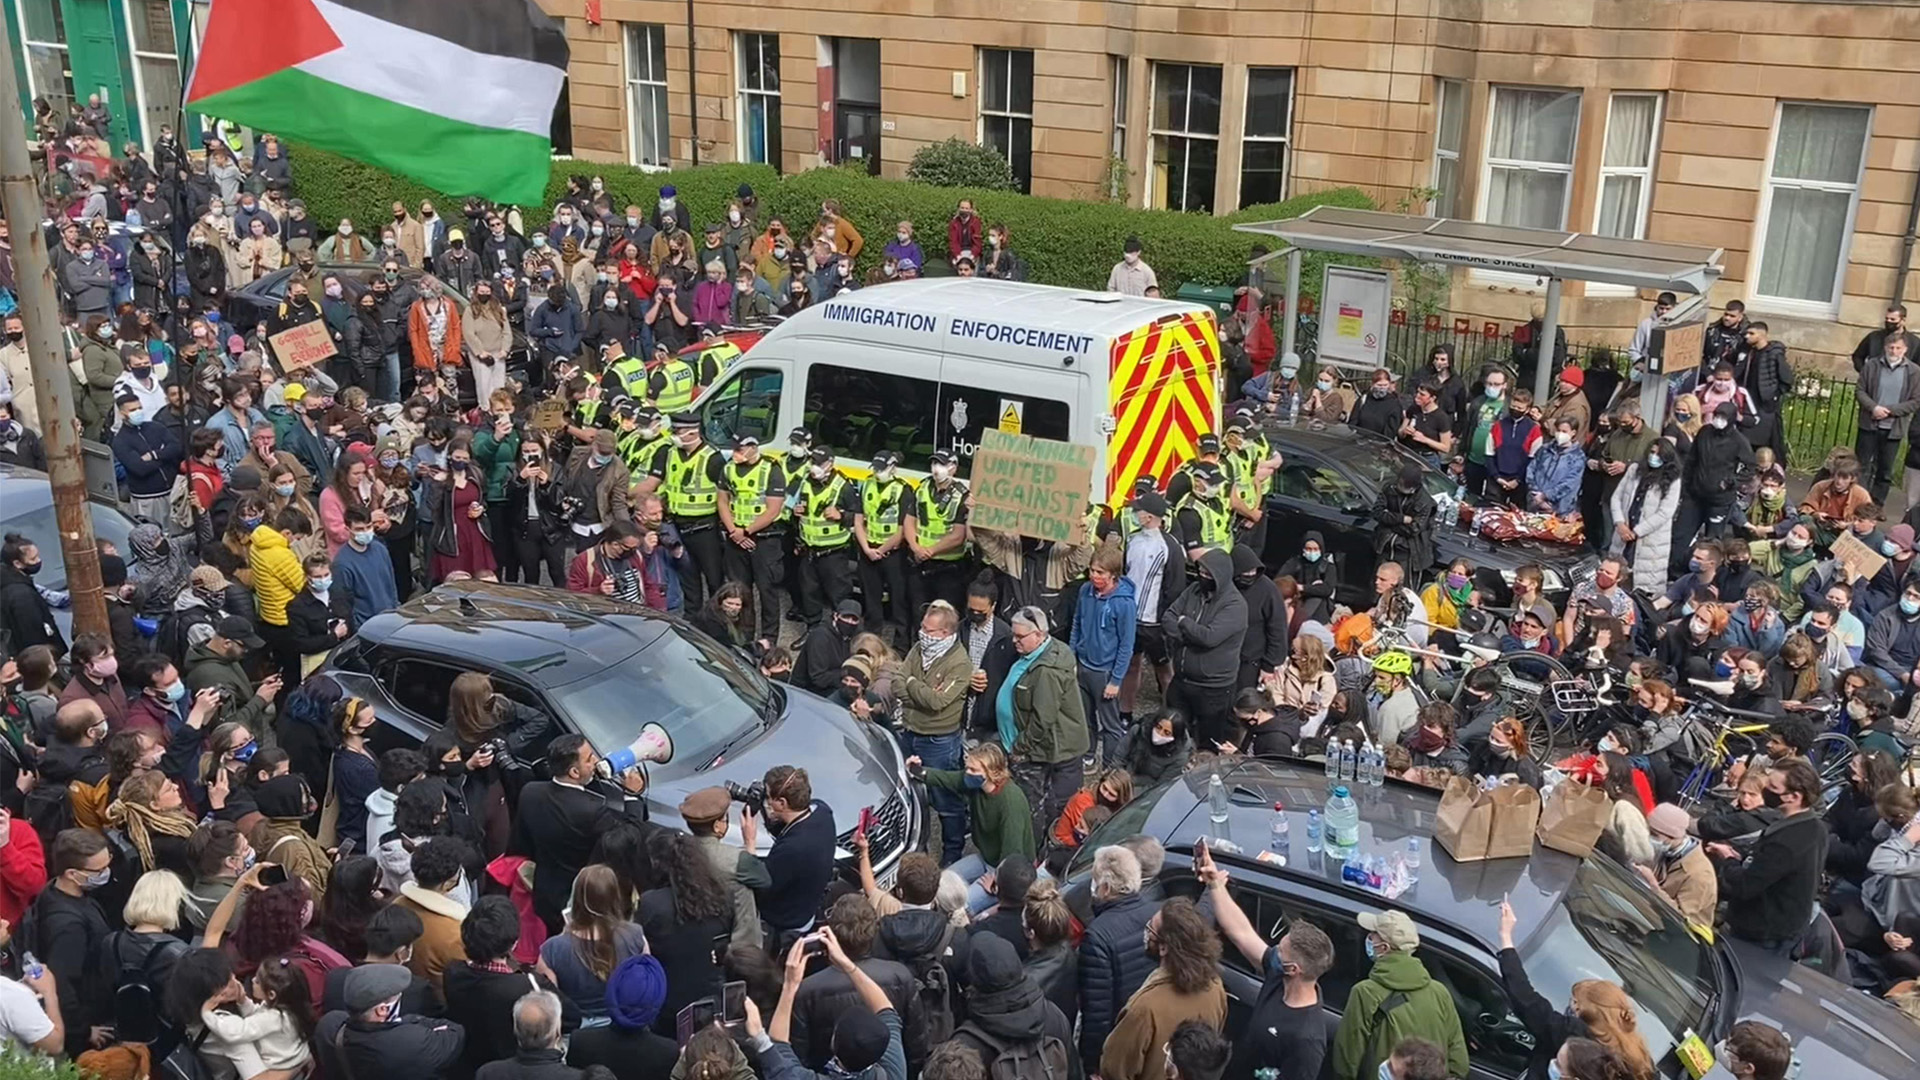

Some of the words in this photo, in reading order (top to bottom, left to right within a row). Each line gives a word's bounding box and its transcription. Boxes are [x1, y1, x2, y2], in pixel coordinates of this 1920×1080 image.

[823, 303, 936, 332] IMMIGRATION
[950, 318, 1093, 354] ENFORCEMENT
[952, 436, 981, 456] Ho
[983, 456, 1056, 485] UNITED
[976, 478, 1080, 516] AGAINST
[973, 504, 1070, 540] EVICTION
